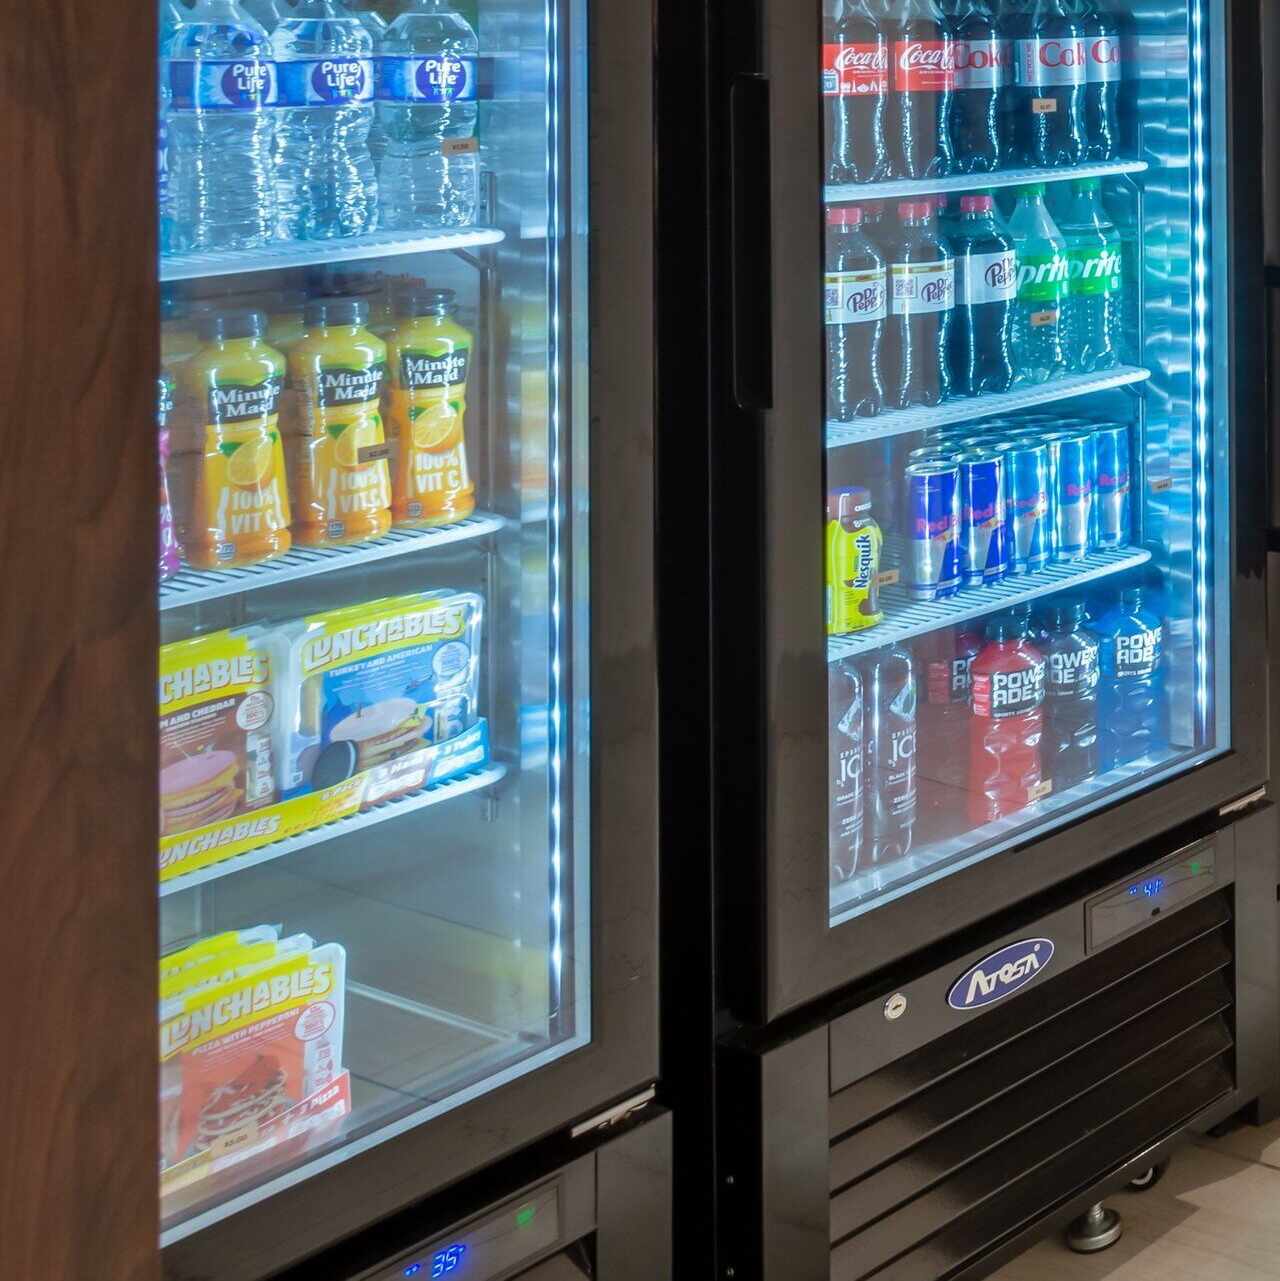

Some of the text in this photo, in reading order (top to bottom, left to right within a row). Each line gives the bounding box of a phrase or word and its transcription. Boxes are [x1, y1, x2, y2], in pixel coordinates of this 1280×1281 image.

[233, 65, 267, 79] Pure
[322, 61, 359, 77] Pure
[426, 61, 461, 75] Pure
[238, 78, 265, 93] Life
[328, 75, 354, 93] Life
[430, 73, 457, 89] Life
[407, 356, 465, 374] Minute
[326, 369, 383, 388] Minute
[415, 368, 458, 385] Maid
[217, 384, 281, 405] Minute
[336, 383, 377, 400] Maid
[227, 400, 274, 418] Maid
[416, 454, 458, 471] 100%
[340, 471, 378, 490] 100%
[416, 471, 460, 493] VIT C
[232, 494, 274, 511] 100%
[341, 492, 368, 514] VIT
[231, 513, 262, 535] VIT
[855, 533, 871, 589] Nesquik
[303, 607, 461, 670] LUNCHABLES
[329, 645, 433, 677] TURKEY AND AMERICAN
[160, 653, 270, 704] CHABLES
[171, 698, 236, 724] AND CHEDDAR
[161, 965, 332, 1055] LUNCHABLES
[193, 1008, 300, 1055] PIZZA WITH PEPPERONI
